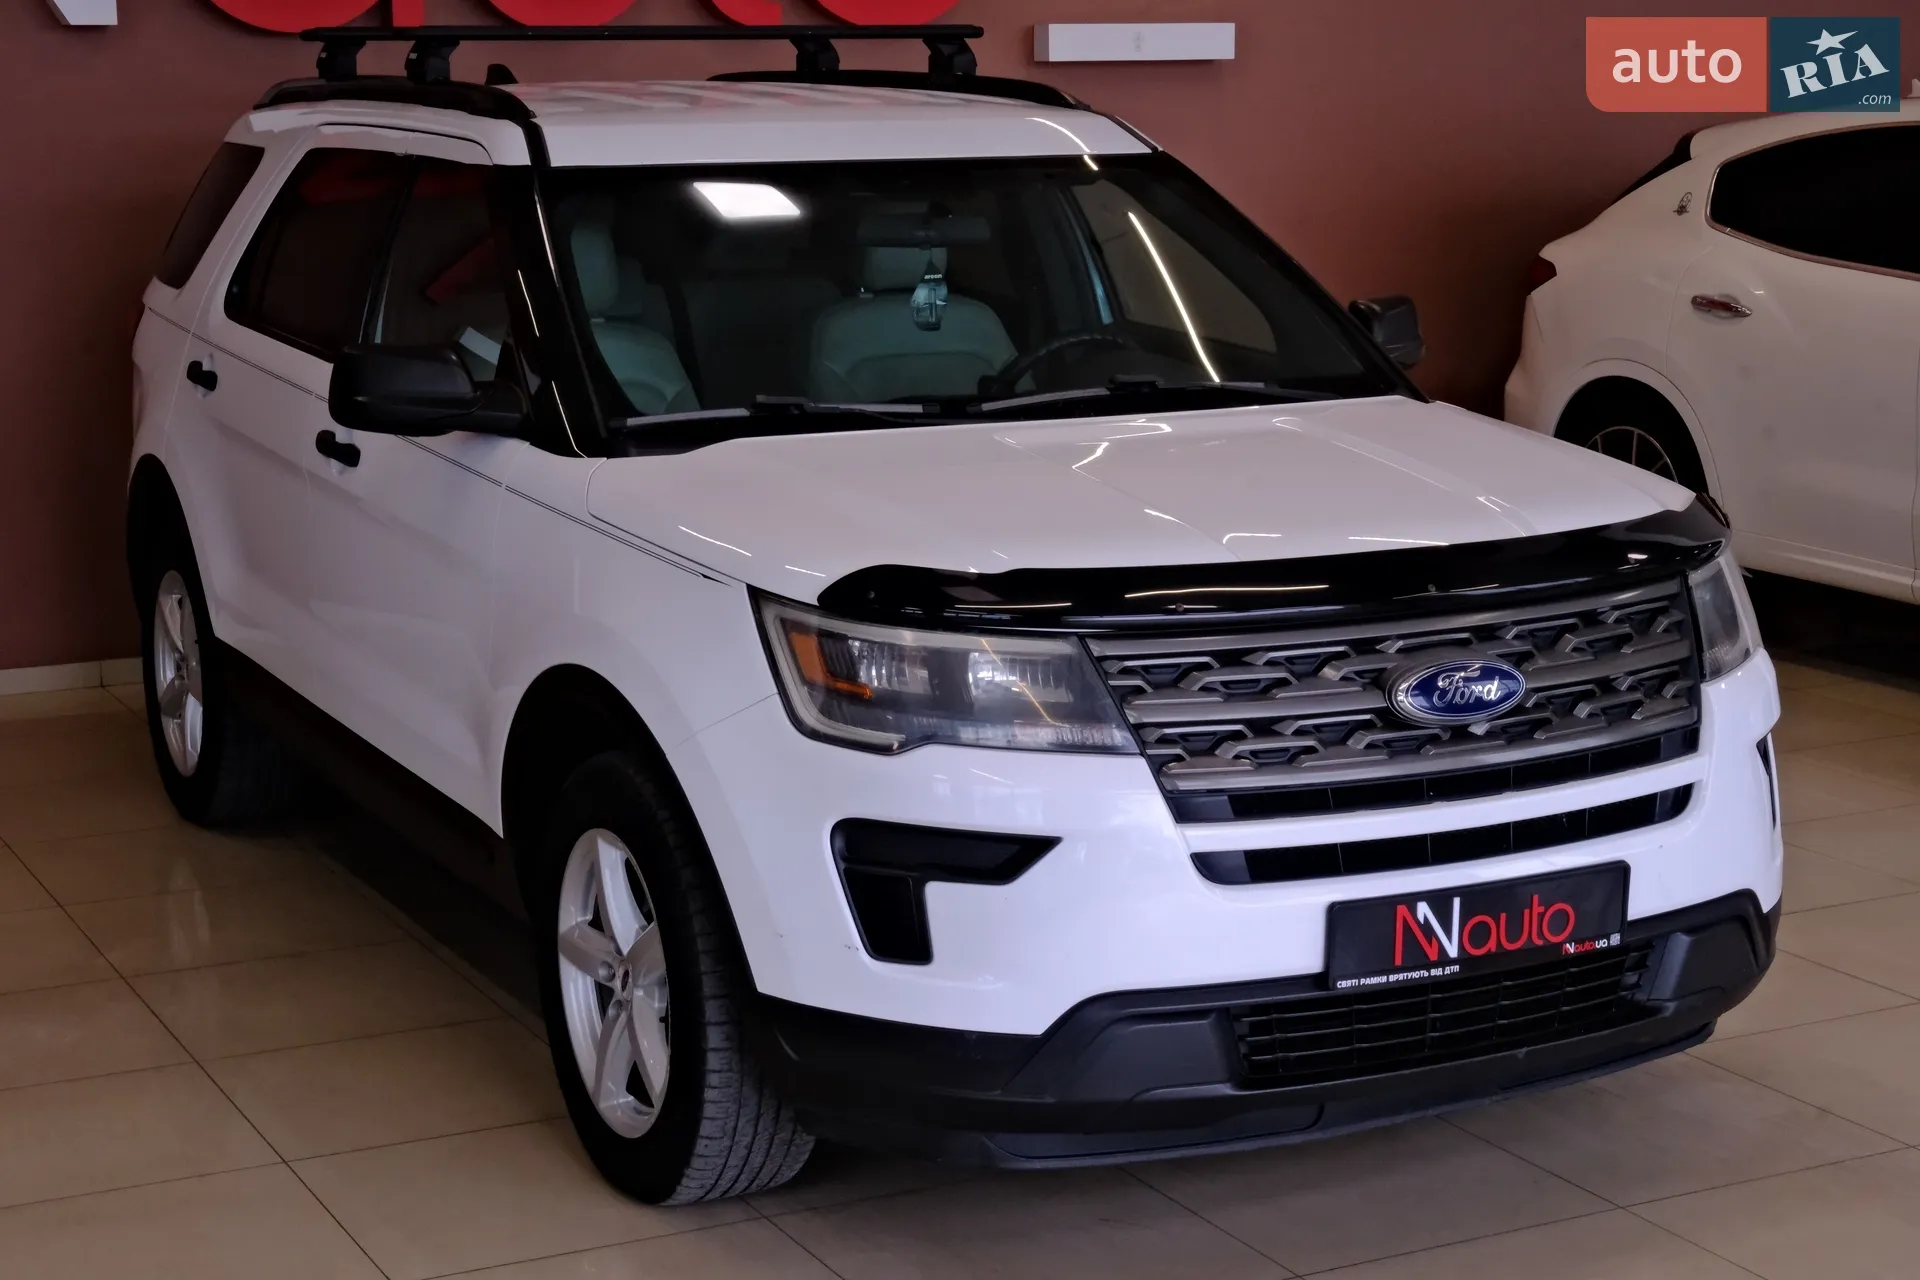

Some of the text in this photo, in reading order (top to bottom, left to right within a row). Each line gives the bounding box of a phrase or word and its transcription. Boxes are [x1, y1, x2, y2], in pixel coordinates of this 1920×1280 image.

[1433, 670, 1501, 708] Ford
[1336, 965, 1460, 988] СВЯТІ РАМКИ ВРЯТУЮТЬ ВІД ДТП
